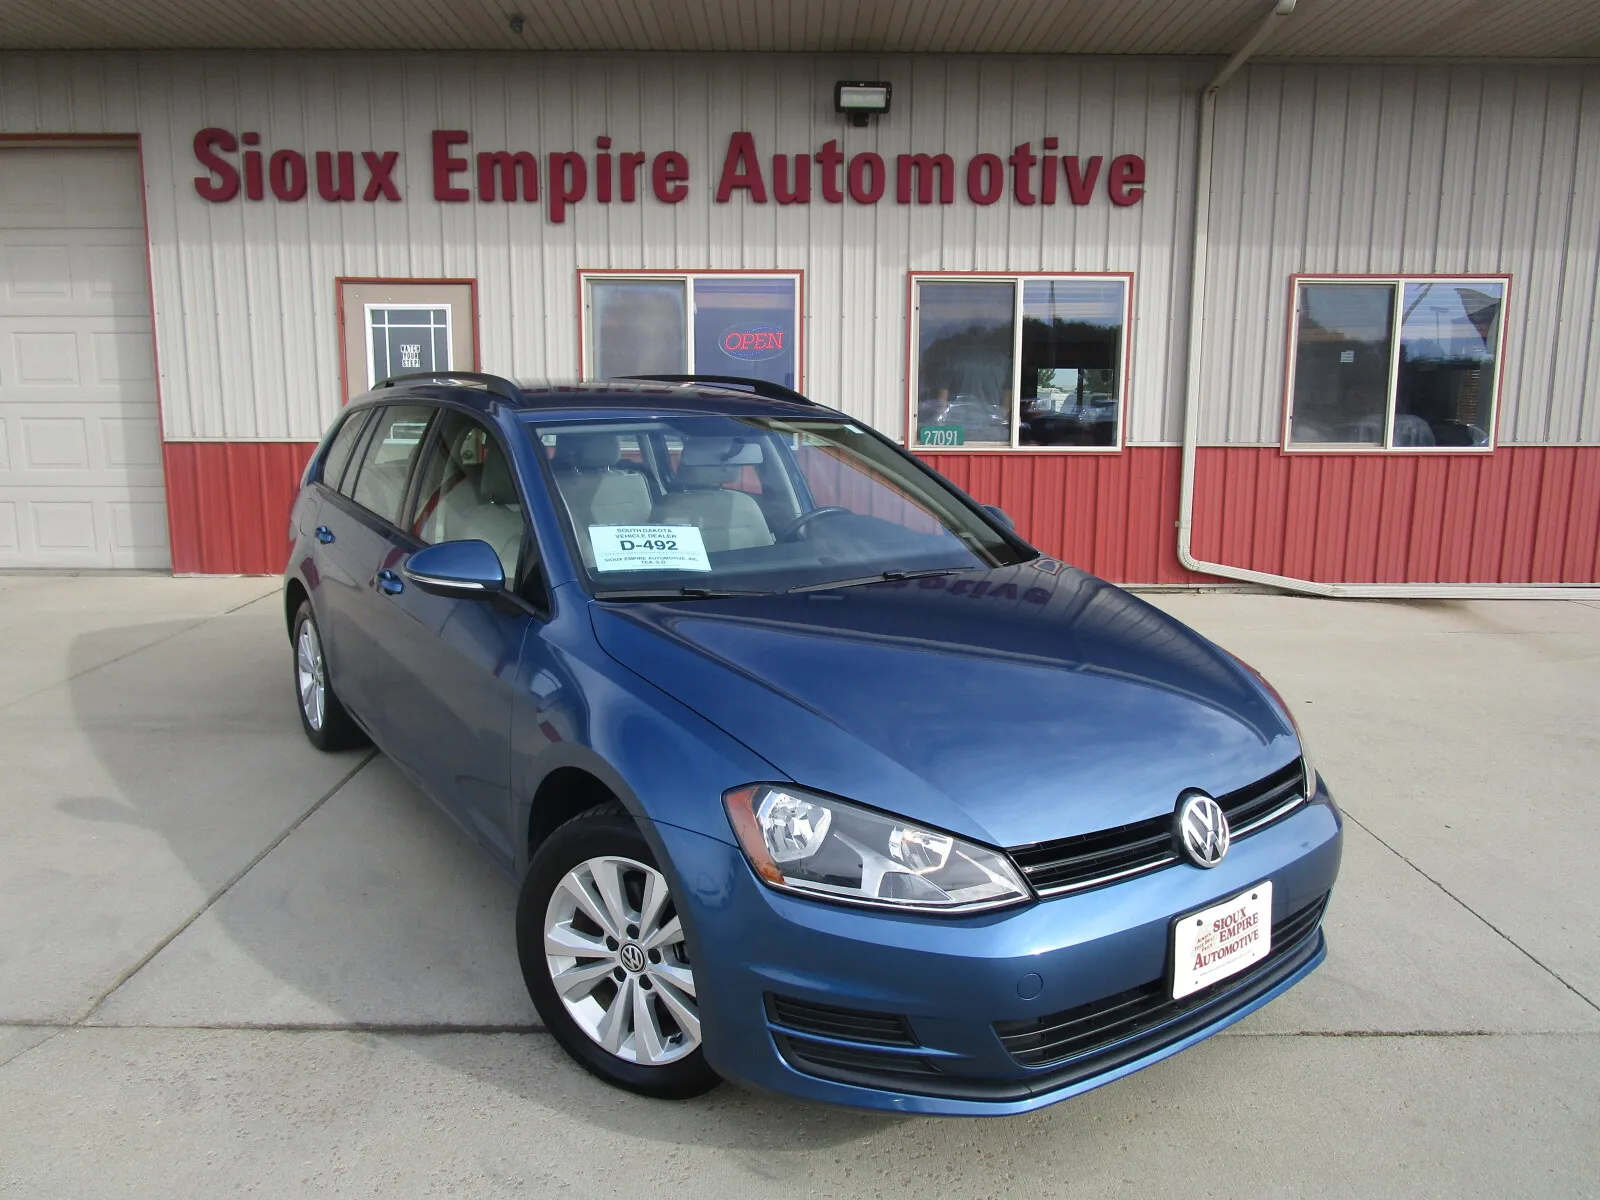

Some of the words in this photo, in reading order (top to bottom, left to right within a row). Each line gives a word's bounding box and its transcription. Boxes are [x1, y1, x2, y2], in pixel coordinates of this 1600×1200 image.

[193, 127, 402, 202] Sioux
[432, 130, 689, 223] Empire
[716, 131, 1146, 206] Automotive
[725, 331, 784, 351] OPEN
[402, 359, 420, 367] STEP!
[924, 430, 958, 446] 27091
[620, 540, 678, 551] D-492
[1213, 906, 1246, 933] SIOUX
[1219, 912, 1259, 943] EMPIRE
[1193, 929, 1259, 971] AUTOMOTIVE
